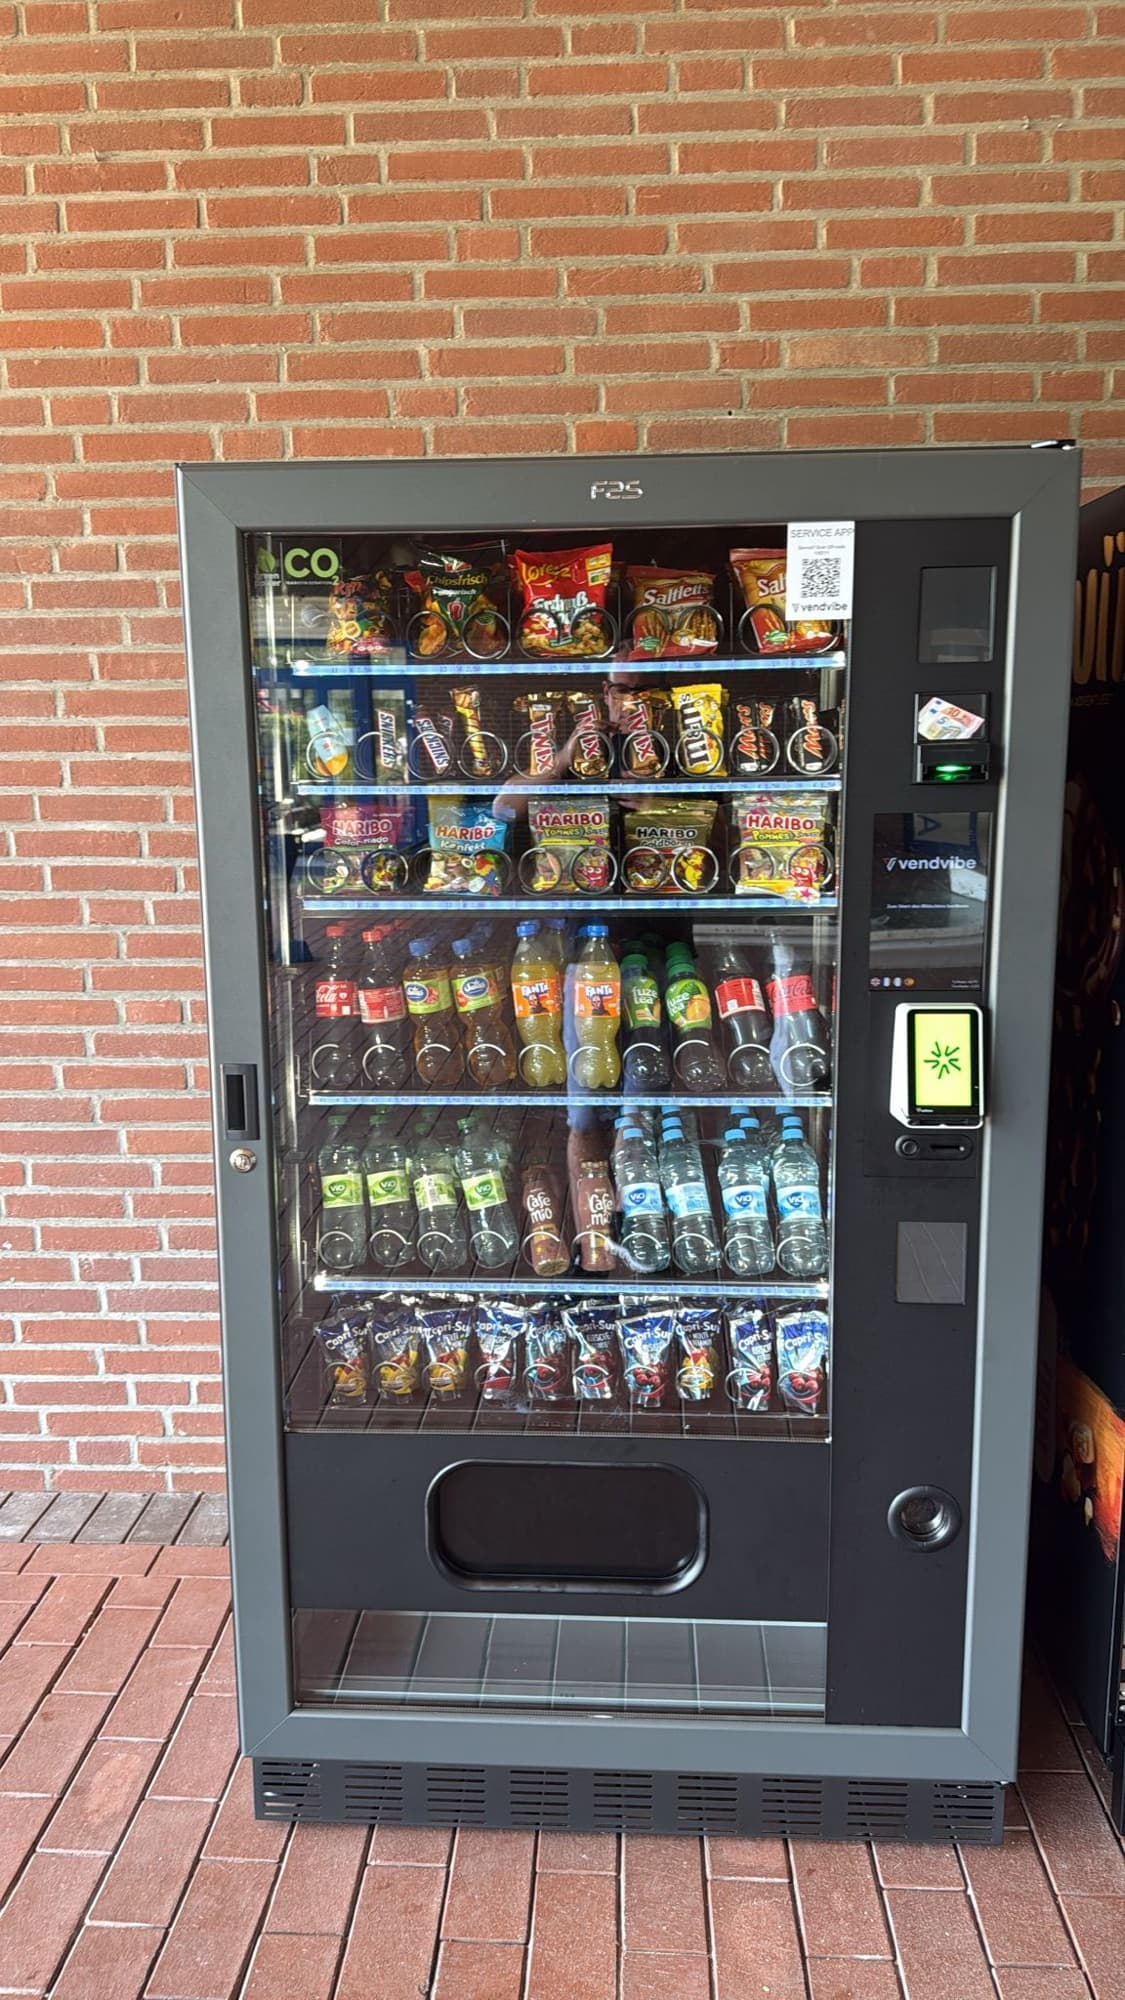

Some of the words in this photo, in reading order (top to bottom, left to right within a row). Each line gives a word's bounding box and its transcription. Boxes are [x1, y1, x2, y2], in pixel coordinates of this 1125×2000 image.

[790, 528, 833, 538] SERVICE
[834, 527, 855, 537] APP
[757, 573, 785, 597] Sal
[801, 601, 848, 612] vendvibe
[574, 703, 601, 759] TWIX
[625, 703, 656, 761] TWIX
[530, 713, 554, 773] TWIX
[537, 811, 604, 827] HARIBO
[747, 814, 816, 831] HARIBO
[332, 819, 393, 837] HARIBO
[436, 825, 495, 841] HARIBO
[636, 827, 698, 840] HARIBO
[898, 856, 977, 870] vendvibe
[738, 1328, 771, 1351] Capri-S
[784, 1331, 828, 1351] Capri-Su
